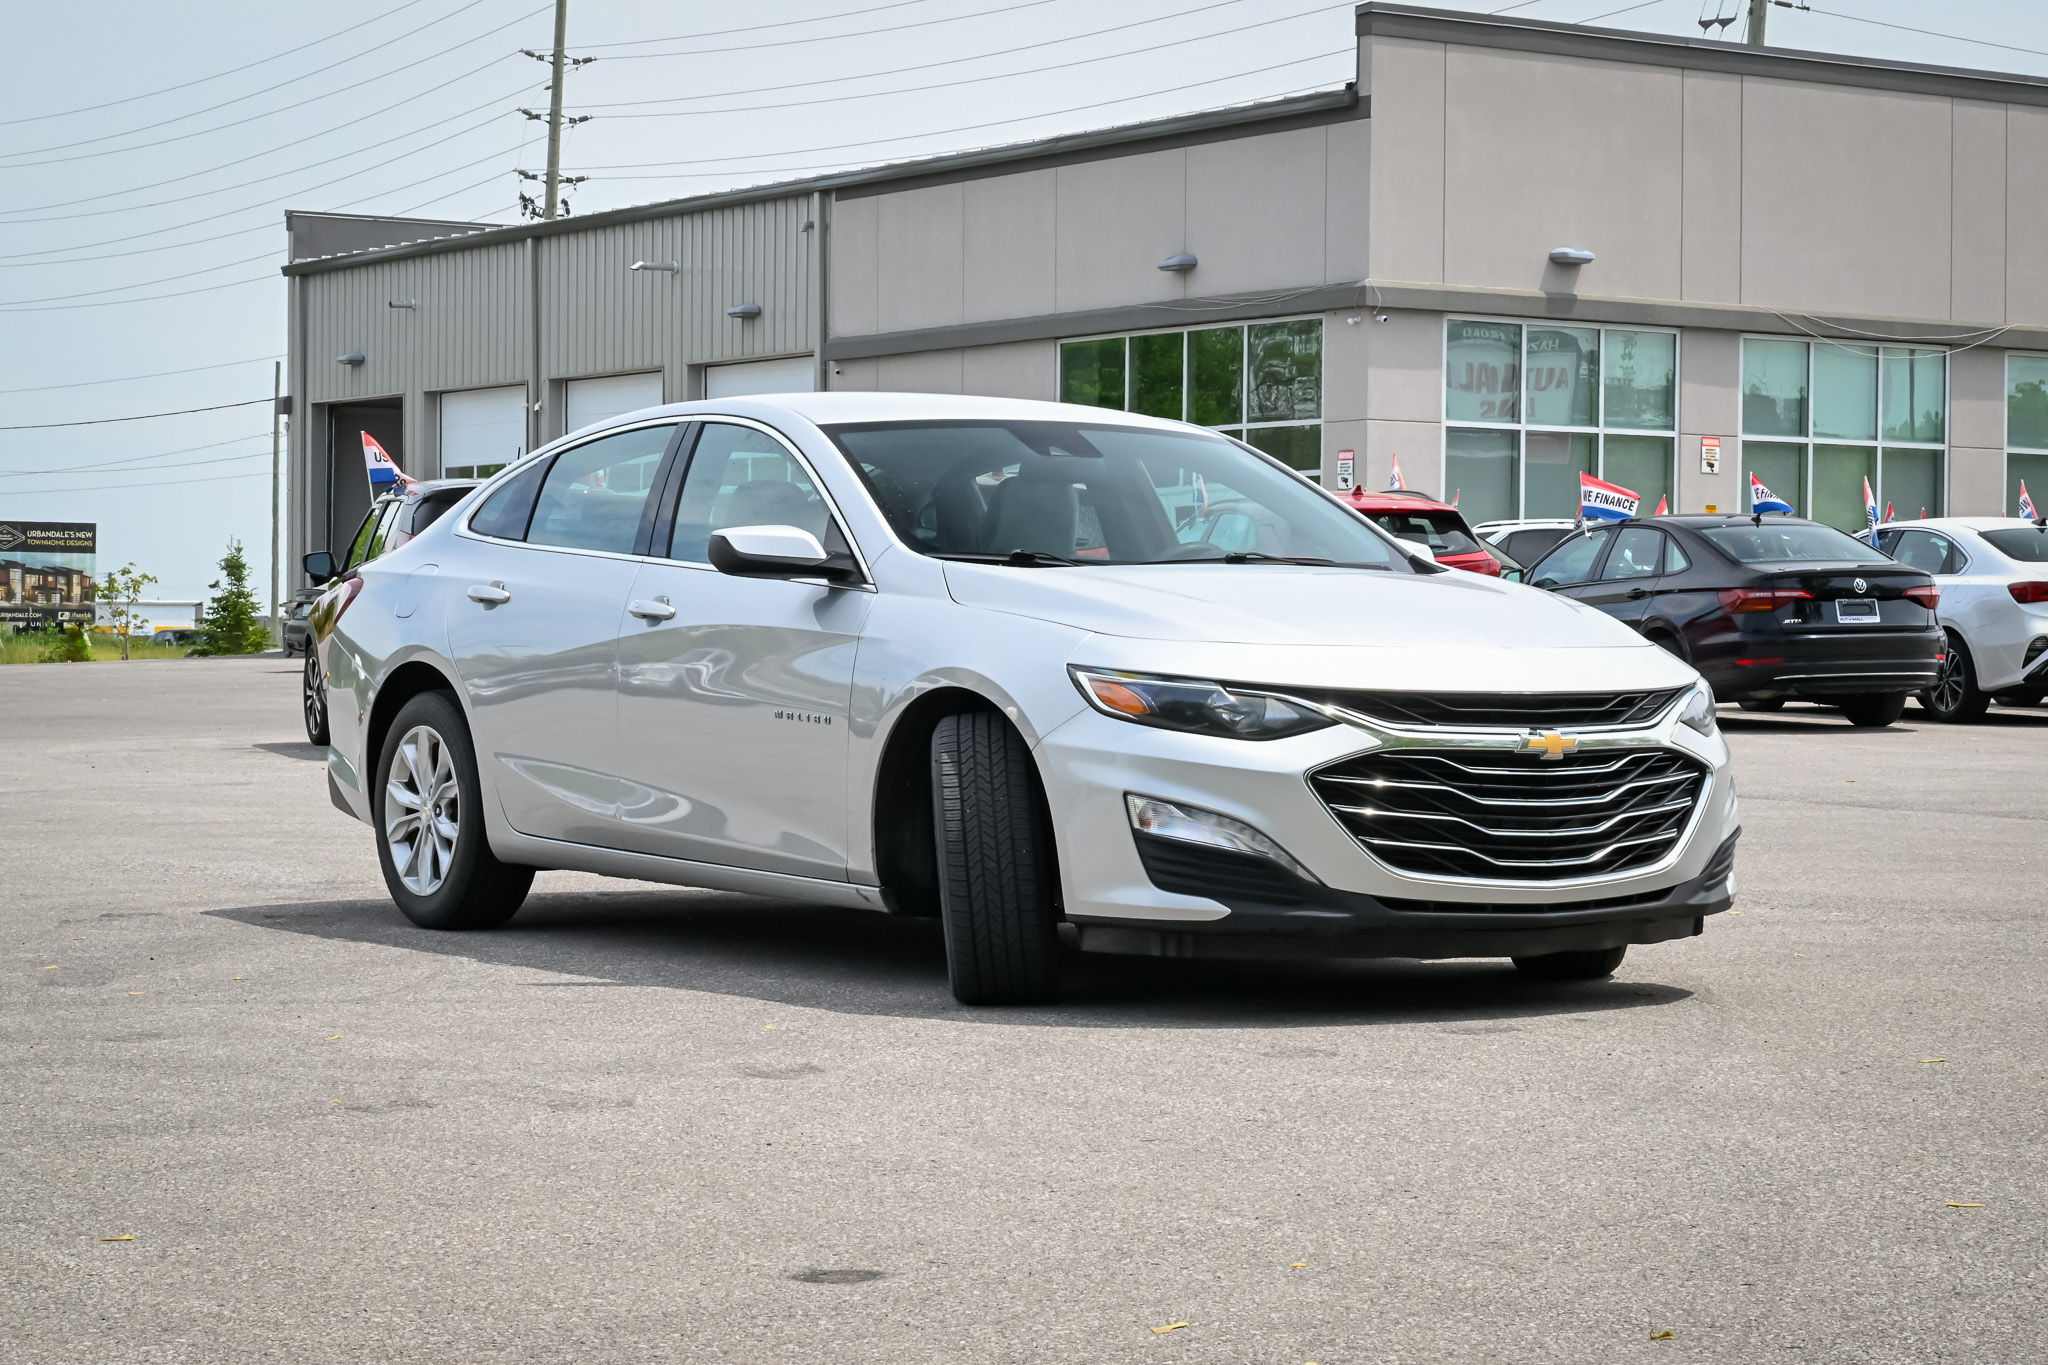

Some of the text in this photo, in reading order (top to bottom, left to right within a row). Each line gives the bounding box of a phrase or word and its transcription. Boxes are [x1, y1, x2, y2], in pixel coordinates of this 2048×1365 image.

[1594, 492, 1635, 511] FINANCE
[27, 530, 75, 538] URBANDALE'S
[66, 539, 93, 547] DESIGNS
